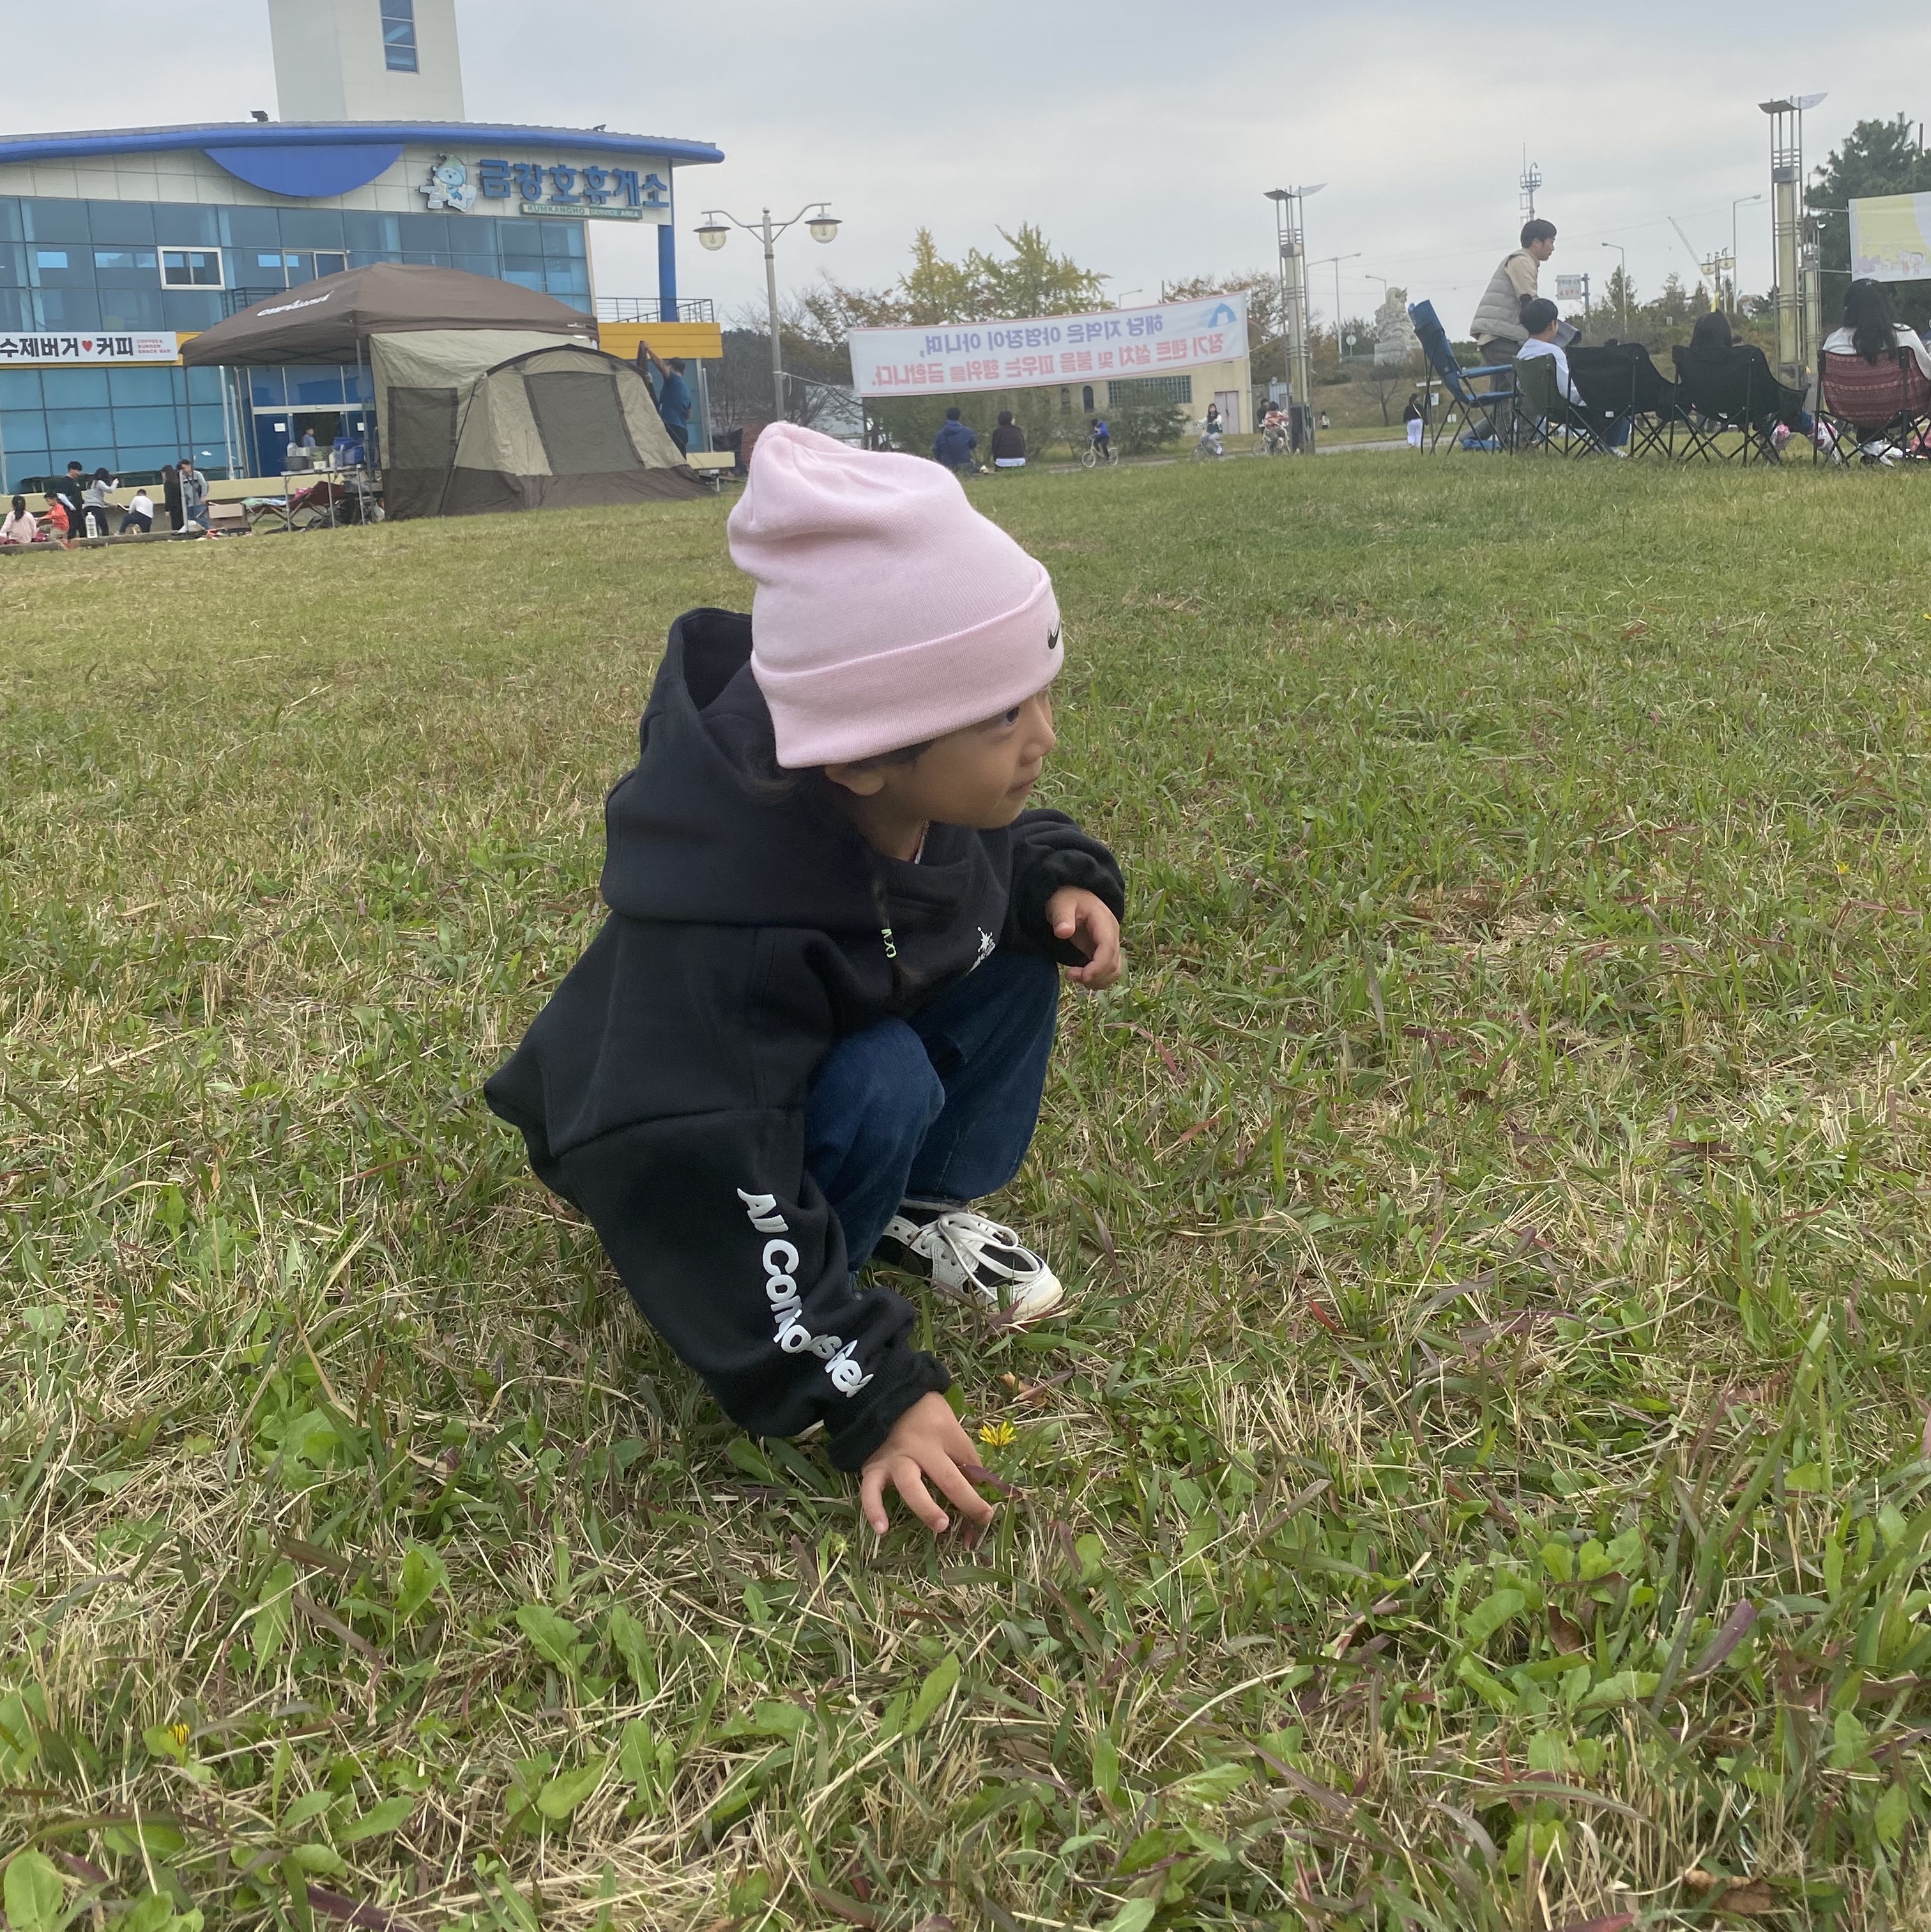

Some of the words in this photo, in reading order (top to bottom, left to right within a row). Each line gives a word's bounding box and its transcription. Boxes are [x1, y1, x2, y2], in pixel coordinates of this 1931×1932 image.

[480, 159, 669, 208] 금강호휴게소
[527, 204, 585, 215] KUMKANGHO
[0, 337, 79, 358] 수제버거
[96, 337, 134, 356] 커피
